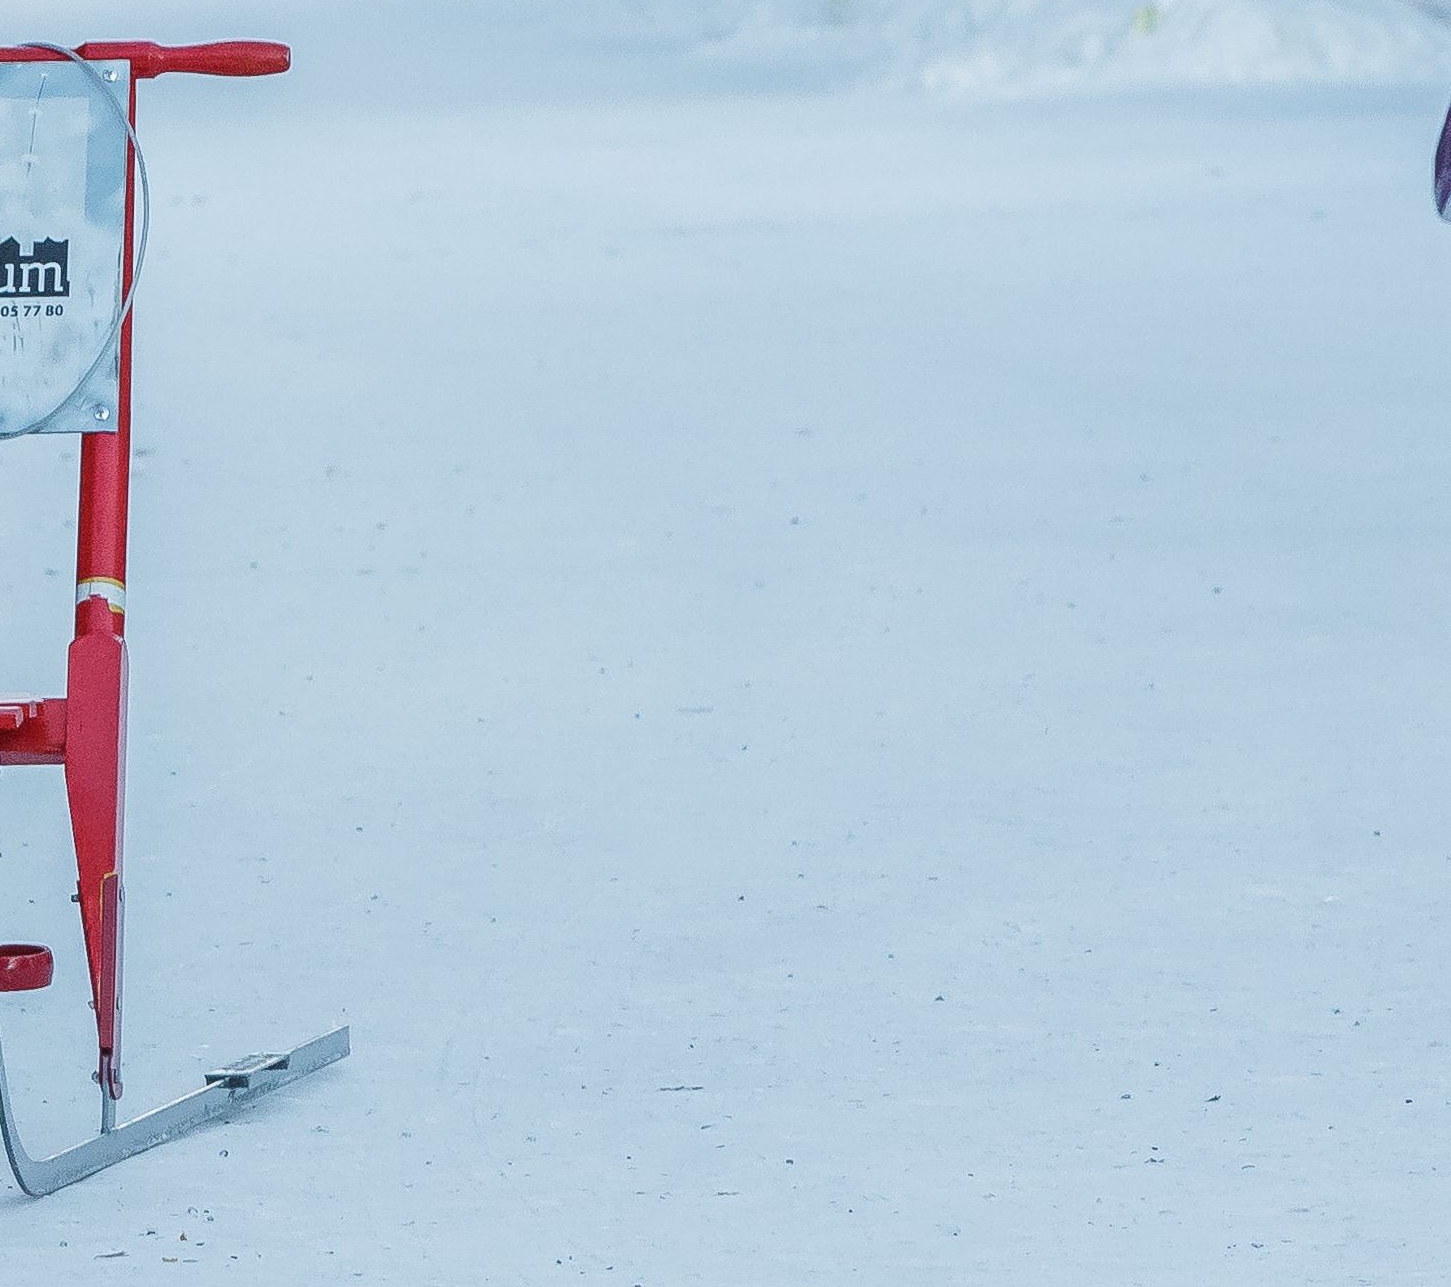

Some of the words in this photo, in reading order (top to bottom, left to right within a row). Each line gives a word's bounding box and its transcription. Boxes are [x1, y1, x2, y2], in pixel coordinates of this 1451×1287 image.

[0, 305, 18, 317] 05
[23, 305, 41, 317] 77
[45, 304, 64, 316] 80
